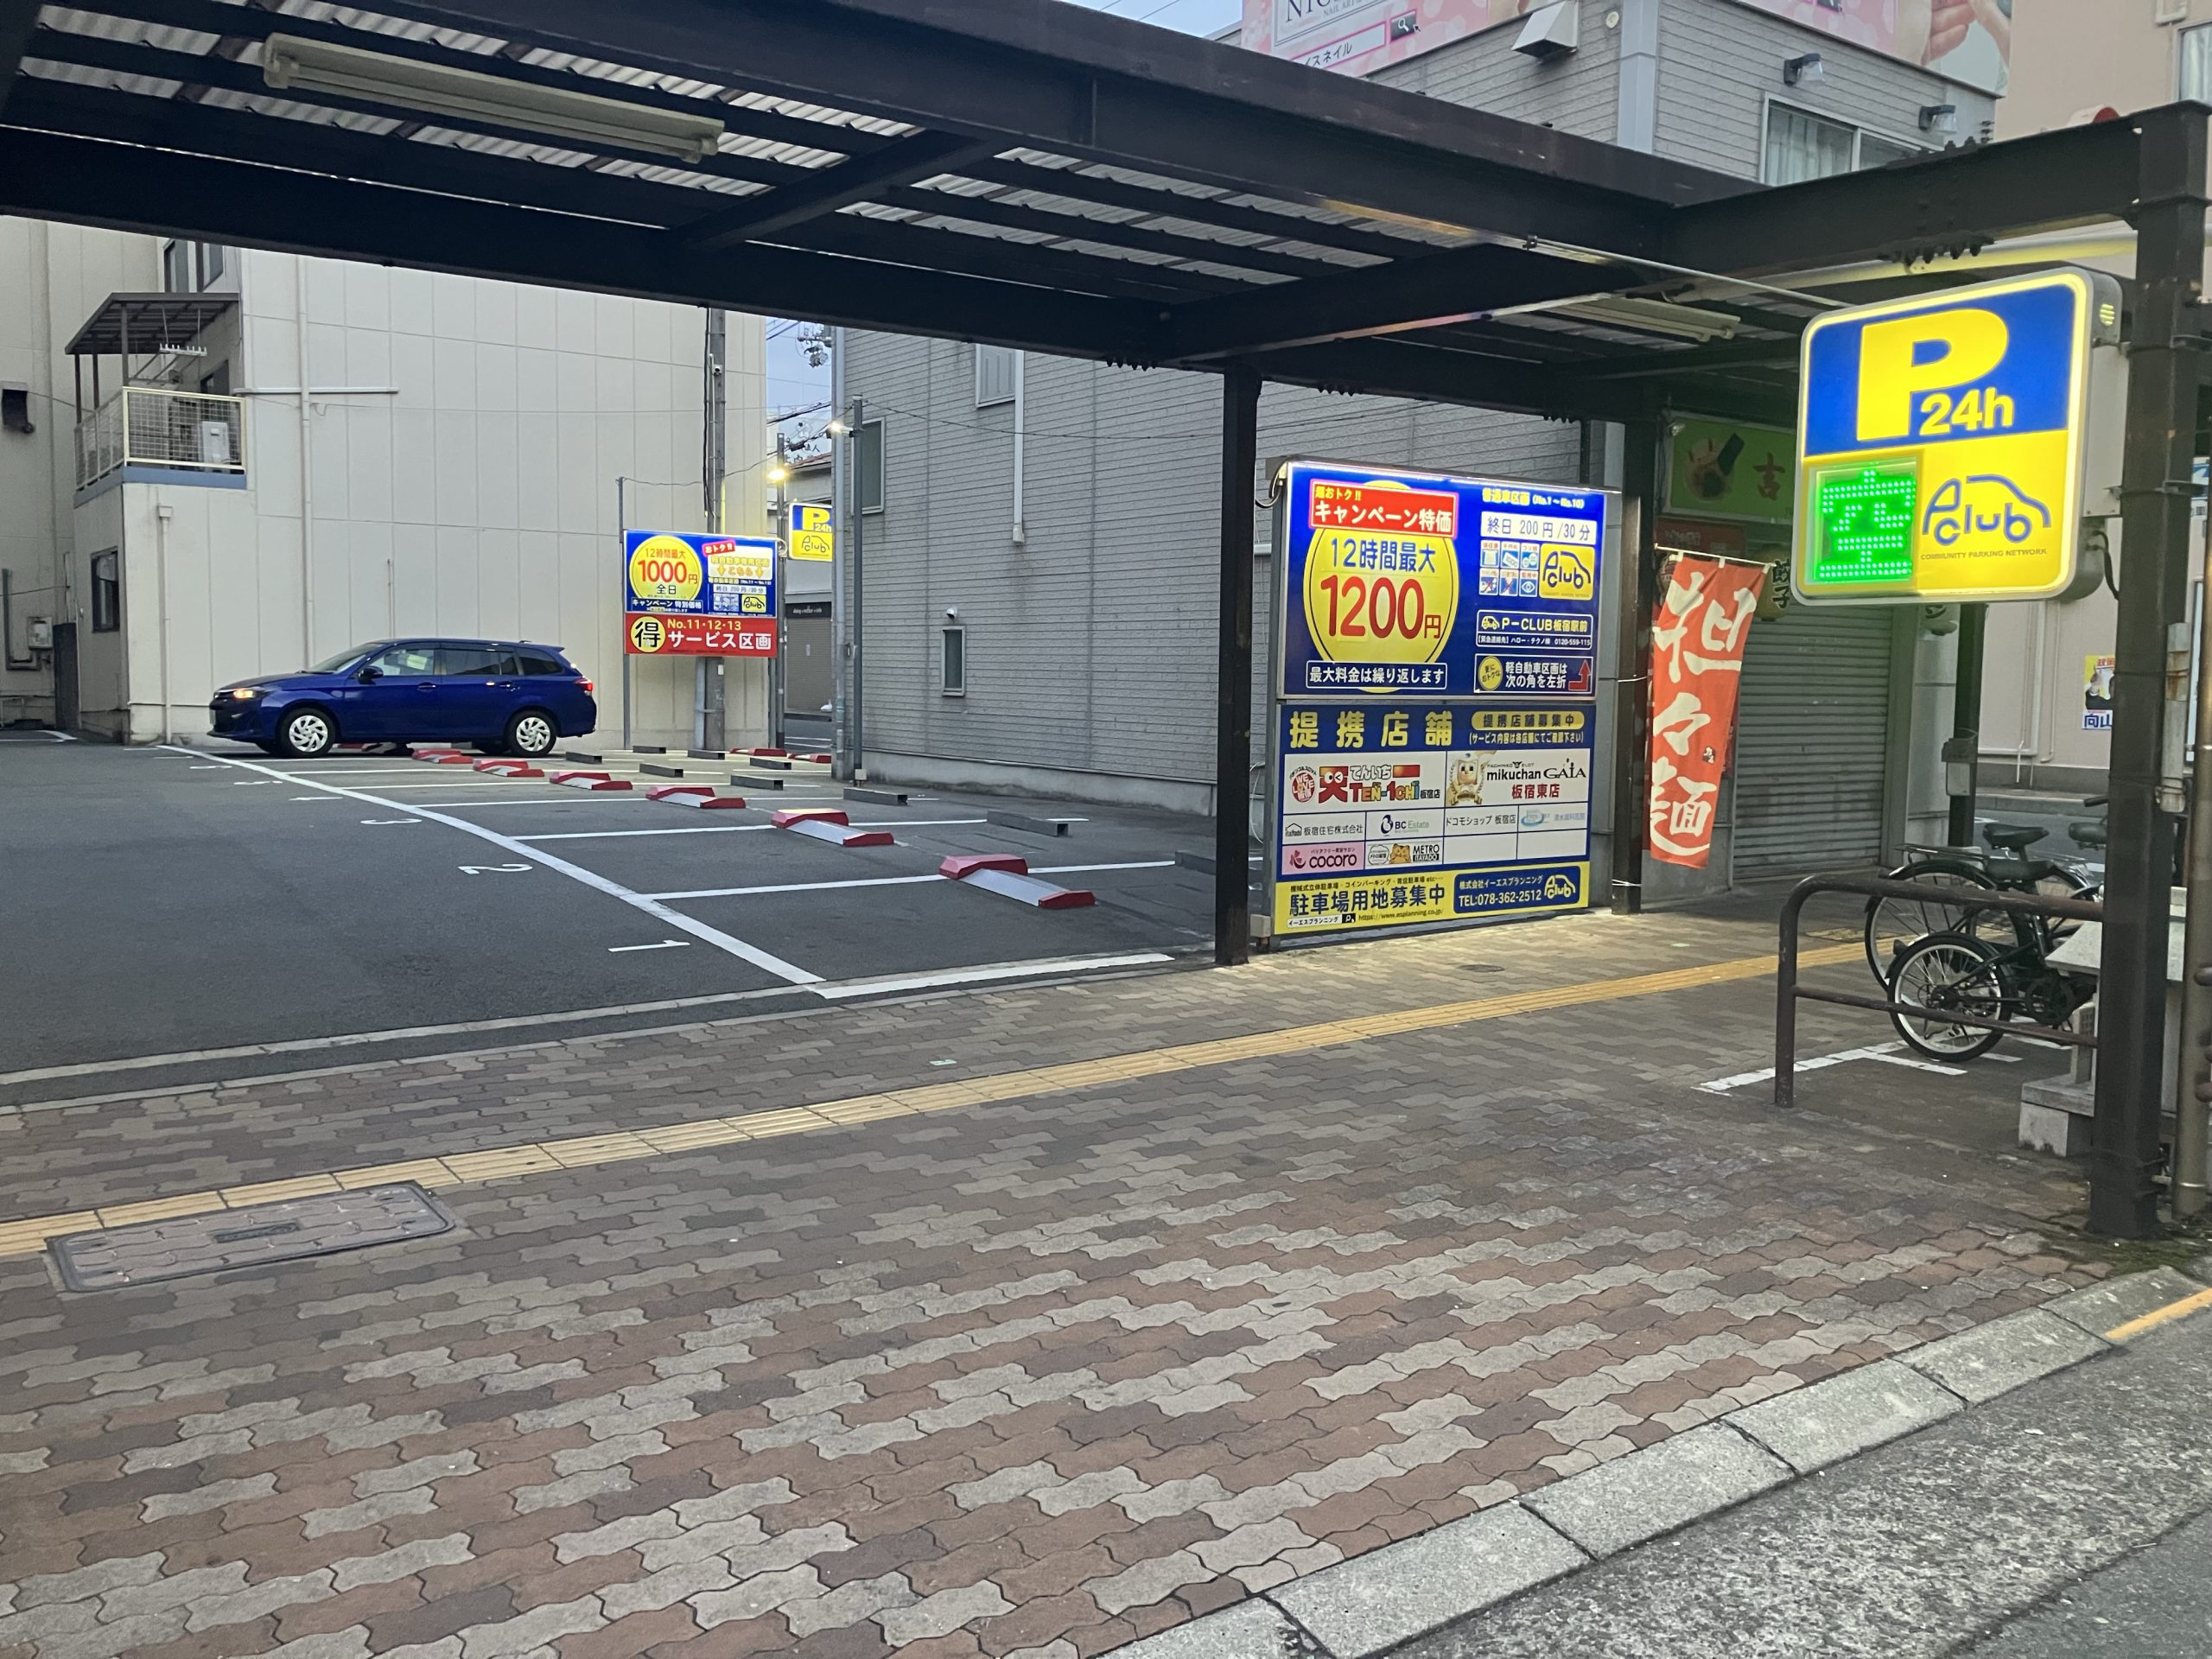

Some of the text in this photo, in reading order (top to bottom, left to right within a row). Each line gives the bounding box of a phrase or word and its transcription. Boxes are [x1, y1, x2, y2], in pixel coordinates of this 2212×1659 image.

[1857, 308, 2008, 441] P
[1919, 387, 2014, 435] 24h
[803, 507, 830, 531] P
[1314, 499, 1452, 532] キャンペーン特価
[1819, 469, 1916, 578] 空
[1487, 516, 1511, 534] 終日
[1332, 537, 1436, 574] 12時間最大
[1921, 548, 2048, 561] COMMUNITY PARKING NETWORK
[657, 583, 677, 595] 全日
[1320, 574, 1441, 639] 1200円
[635, 621, 660, 647] 得
[668, 631, 772, 650] サービス区画
[1309, 667, 1445, 684] 最大料金は繰り返します
[1505, 675, 1567, 689] 次の角を左折
[1289, 711, 1452, 748] 提携店舗
[1487, 768, 1541, 780] mikuchan
[1512, 783, 1560, 799] 板宿東店
[1304, 824, 1363, 836] 板宿住宅株式会社
[1446, 815, 1492, 827] ドコモショップ
[1413, 844, 1440, 854] METRO
[1309, 855, 1357, 868] cocoro
[1290, 884, 1445, 916] 駐車場用地募集中
